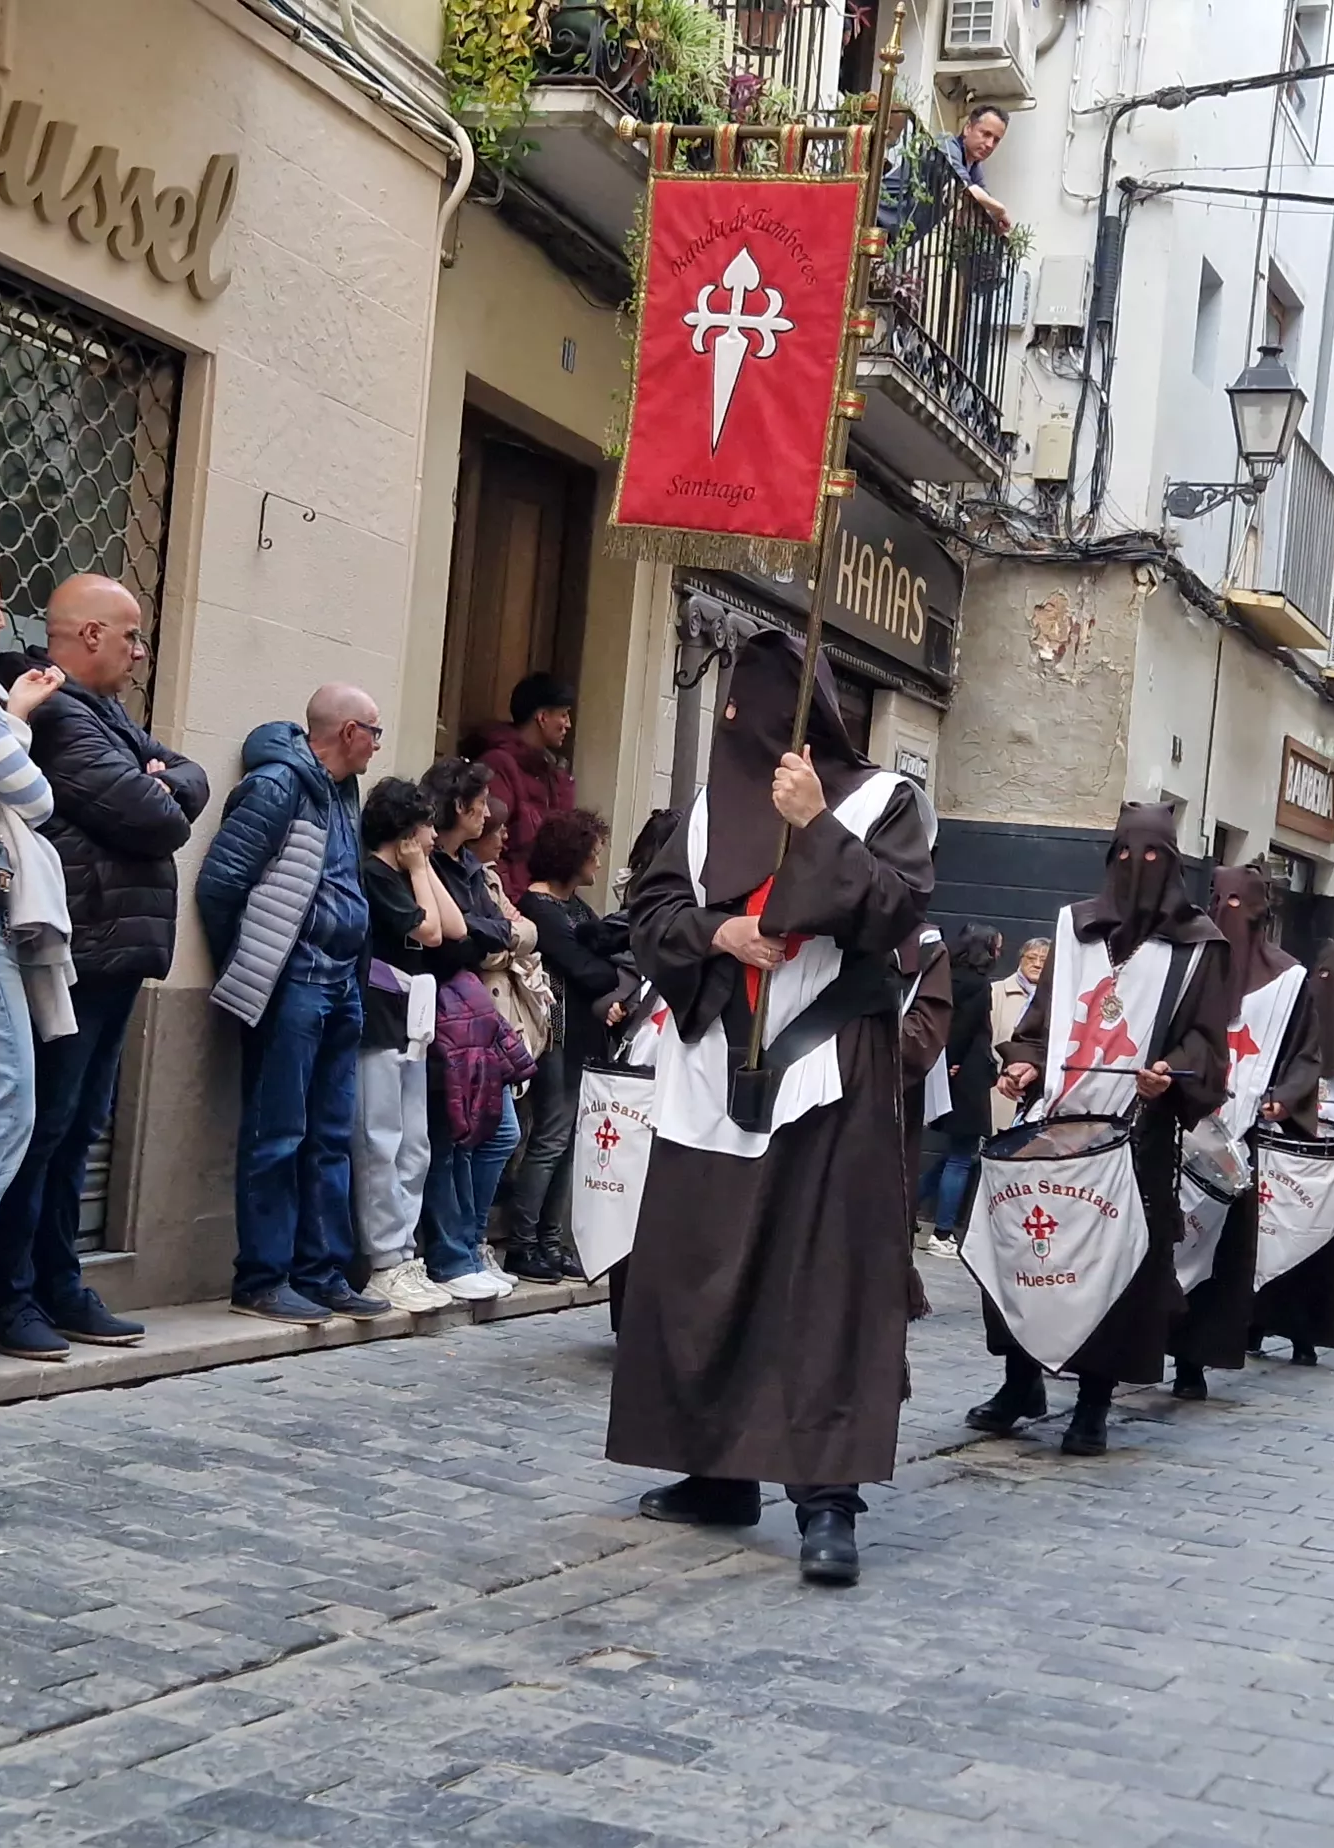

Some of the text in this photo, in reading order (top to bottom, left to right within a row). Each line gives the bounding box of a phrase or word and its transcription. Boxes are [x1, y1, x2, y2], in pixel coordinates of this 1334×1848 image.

[672, 205, 824, 289] Banda de Tambores
[667, 475, 756, 508] Santiago
[835, 529, 927, 645] KAÑAS
[584, 1174, 625, 1193] Huesca
[1038, 1179, 1119, 1219] Santiago
[1267, 1169, 1315, 1209] Santiago
[1015, 1270, 1077, 1288] Huesca
